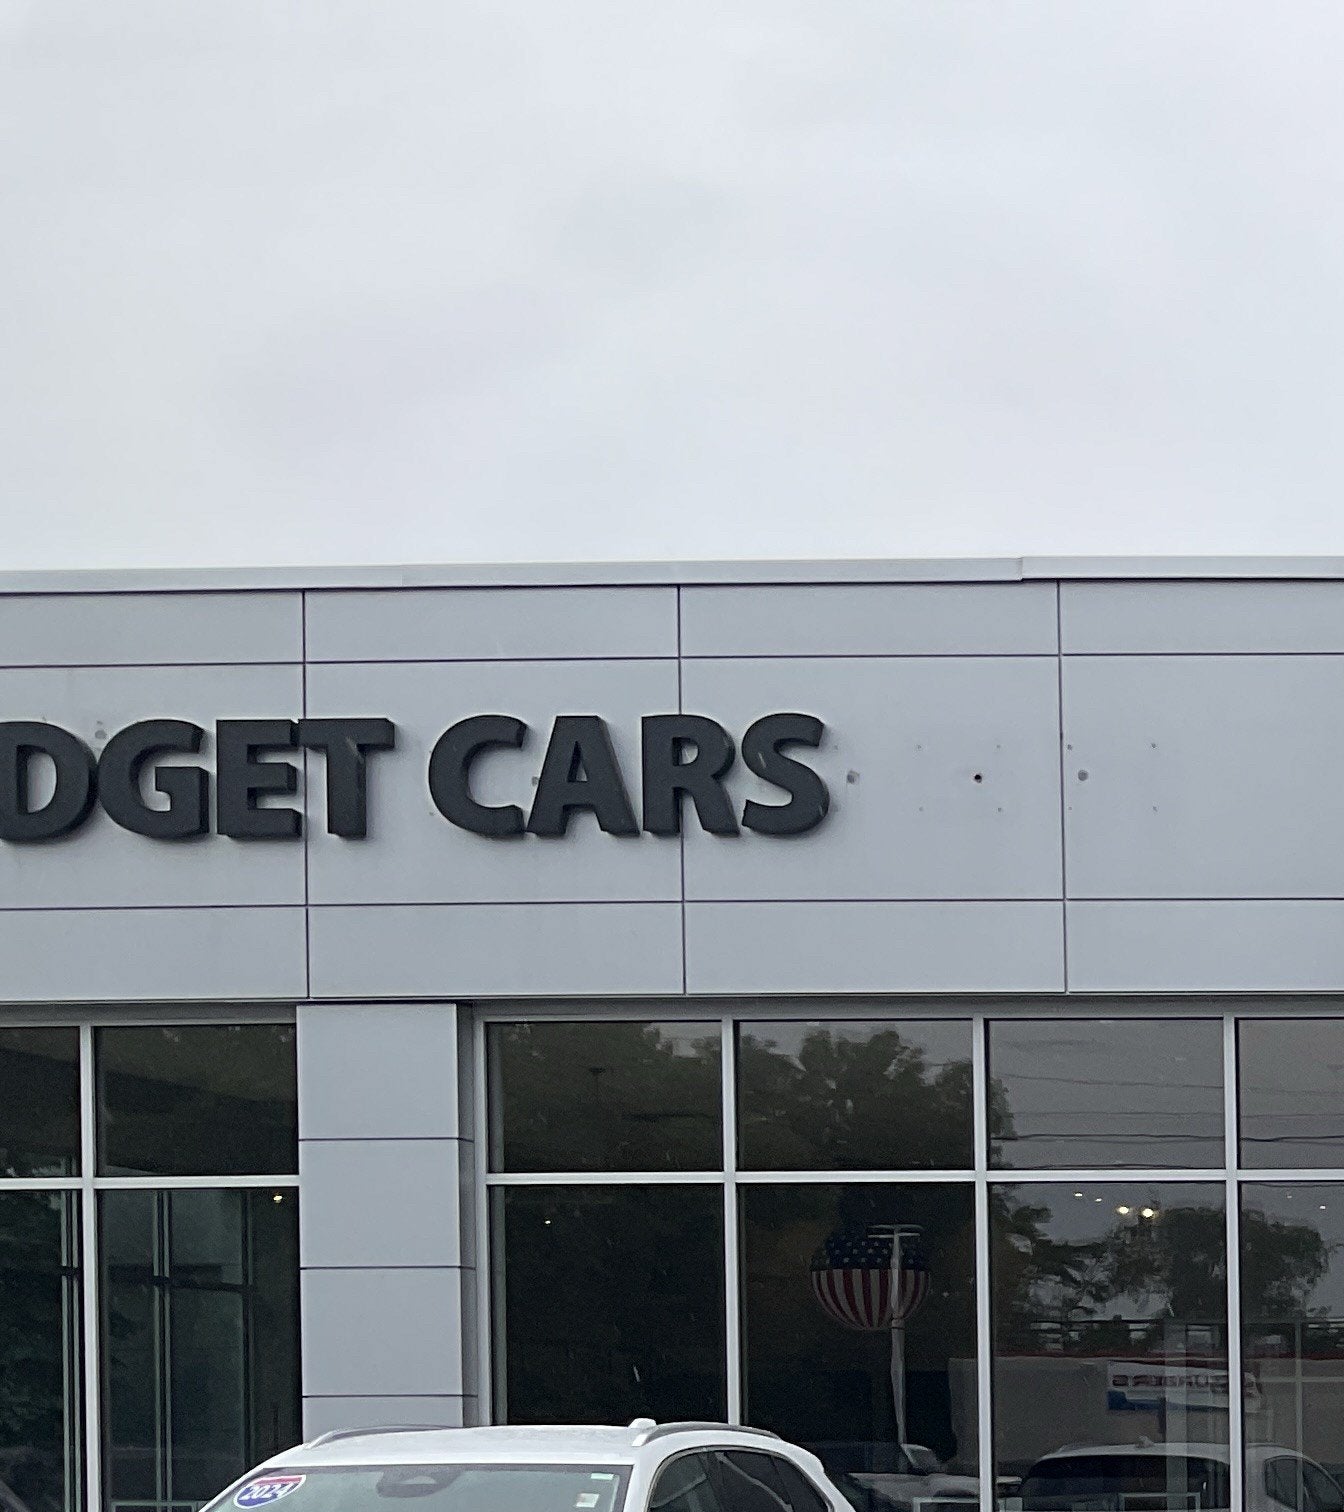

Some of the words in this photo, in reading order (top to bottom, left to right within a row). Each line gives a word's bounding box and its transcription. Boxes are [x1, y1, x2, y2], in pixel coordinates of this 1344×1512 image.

[0, 718, 397, 846] DGET
[429, 713, 831, 842] CARS
[239, 1481, 297, 1501] 2024
